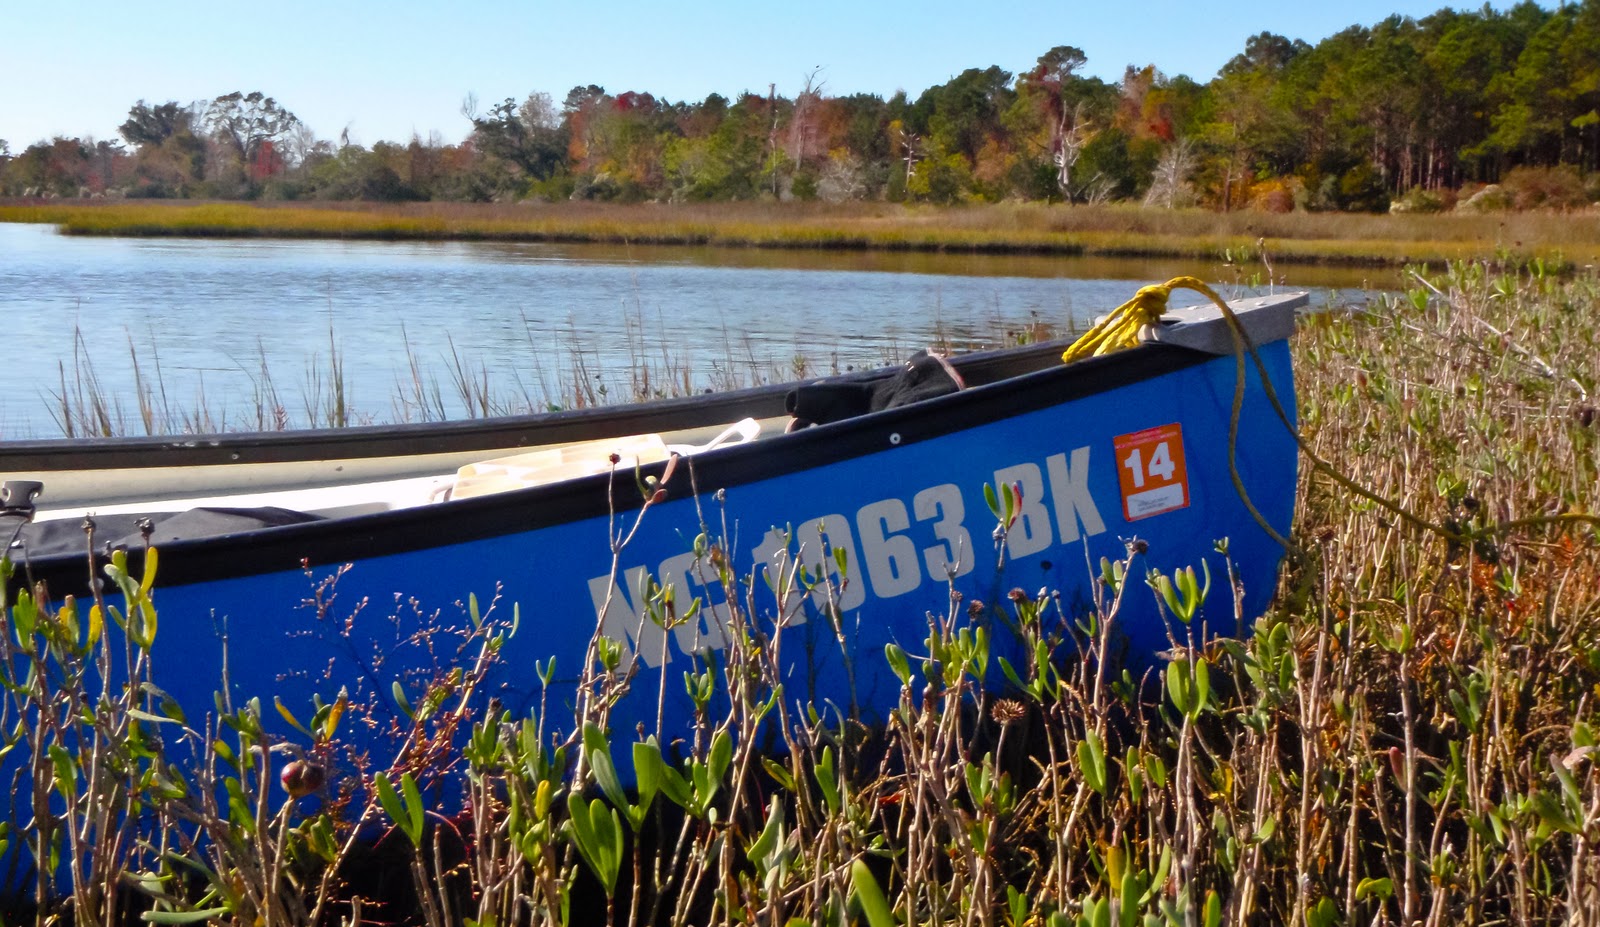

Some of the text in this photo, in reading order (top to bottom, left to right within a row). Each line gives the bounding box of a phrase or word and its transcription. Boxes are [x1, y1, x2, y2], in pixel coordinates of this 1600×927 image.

[1124, 441, 1175, 488] 14
[588, 446, 1107, 675] NC 1963 BK
